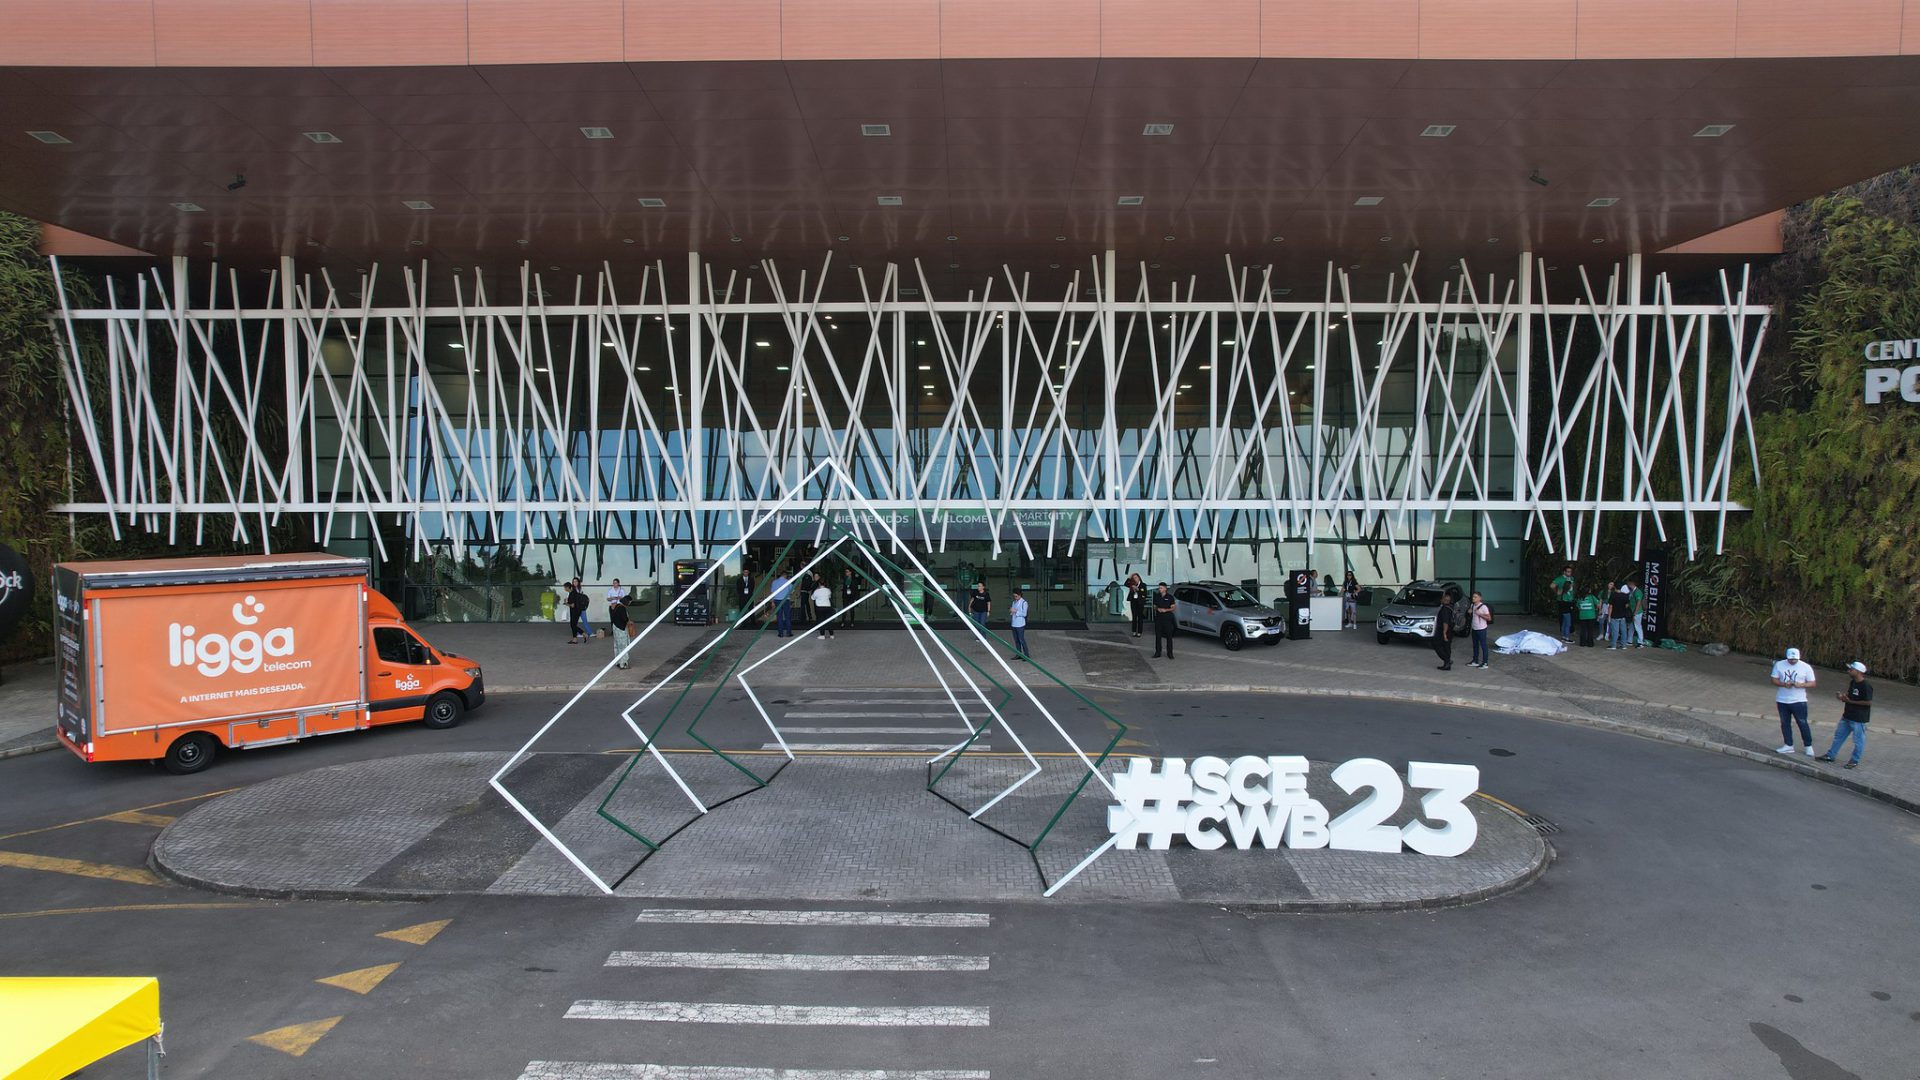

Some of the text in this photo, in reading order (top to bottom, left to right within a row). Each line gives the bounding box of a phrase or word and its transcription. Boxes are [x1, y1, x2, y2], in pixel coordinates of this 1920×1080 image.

[1647, 562, 1660, 633] MOBILIZE
[169, 622, 295, 678] ligga
[263, 660, 312, 673] telecom
[180, 682, 306, 704] A INTERNET MAIS DESEJADA.
[1114, 755, 1310, 806] #SCE
[1106, 799, 1330, 850] #CWB
[1328, 757, 1480, 858] 23
